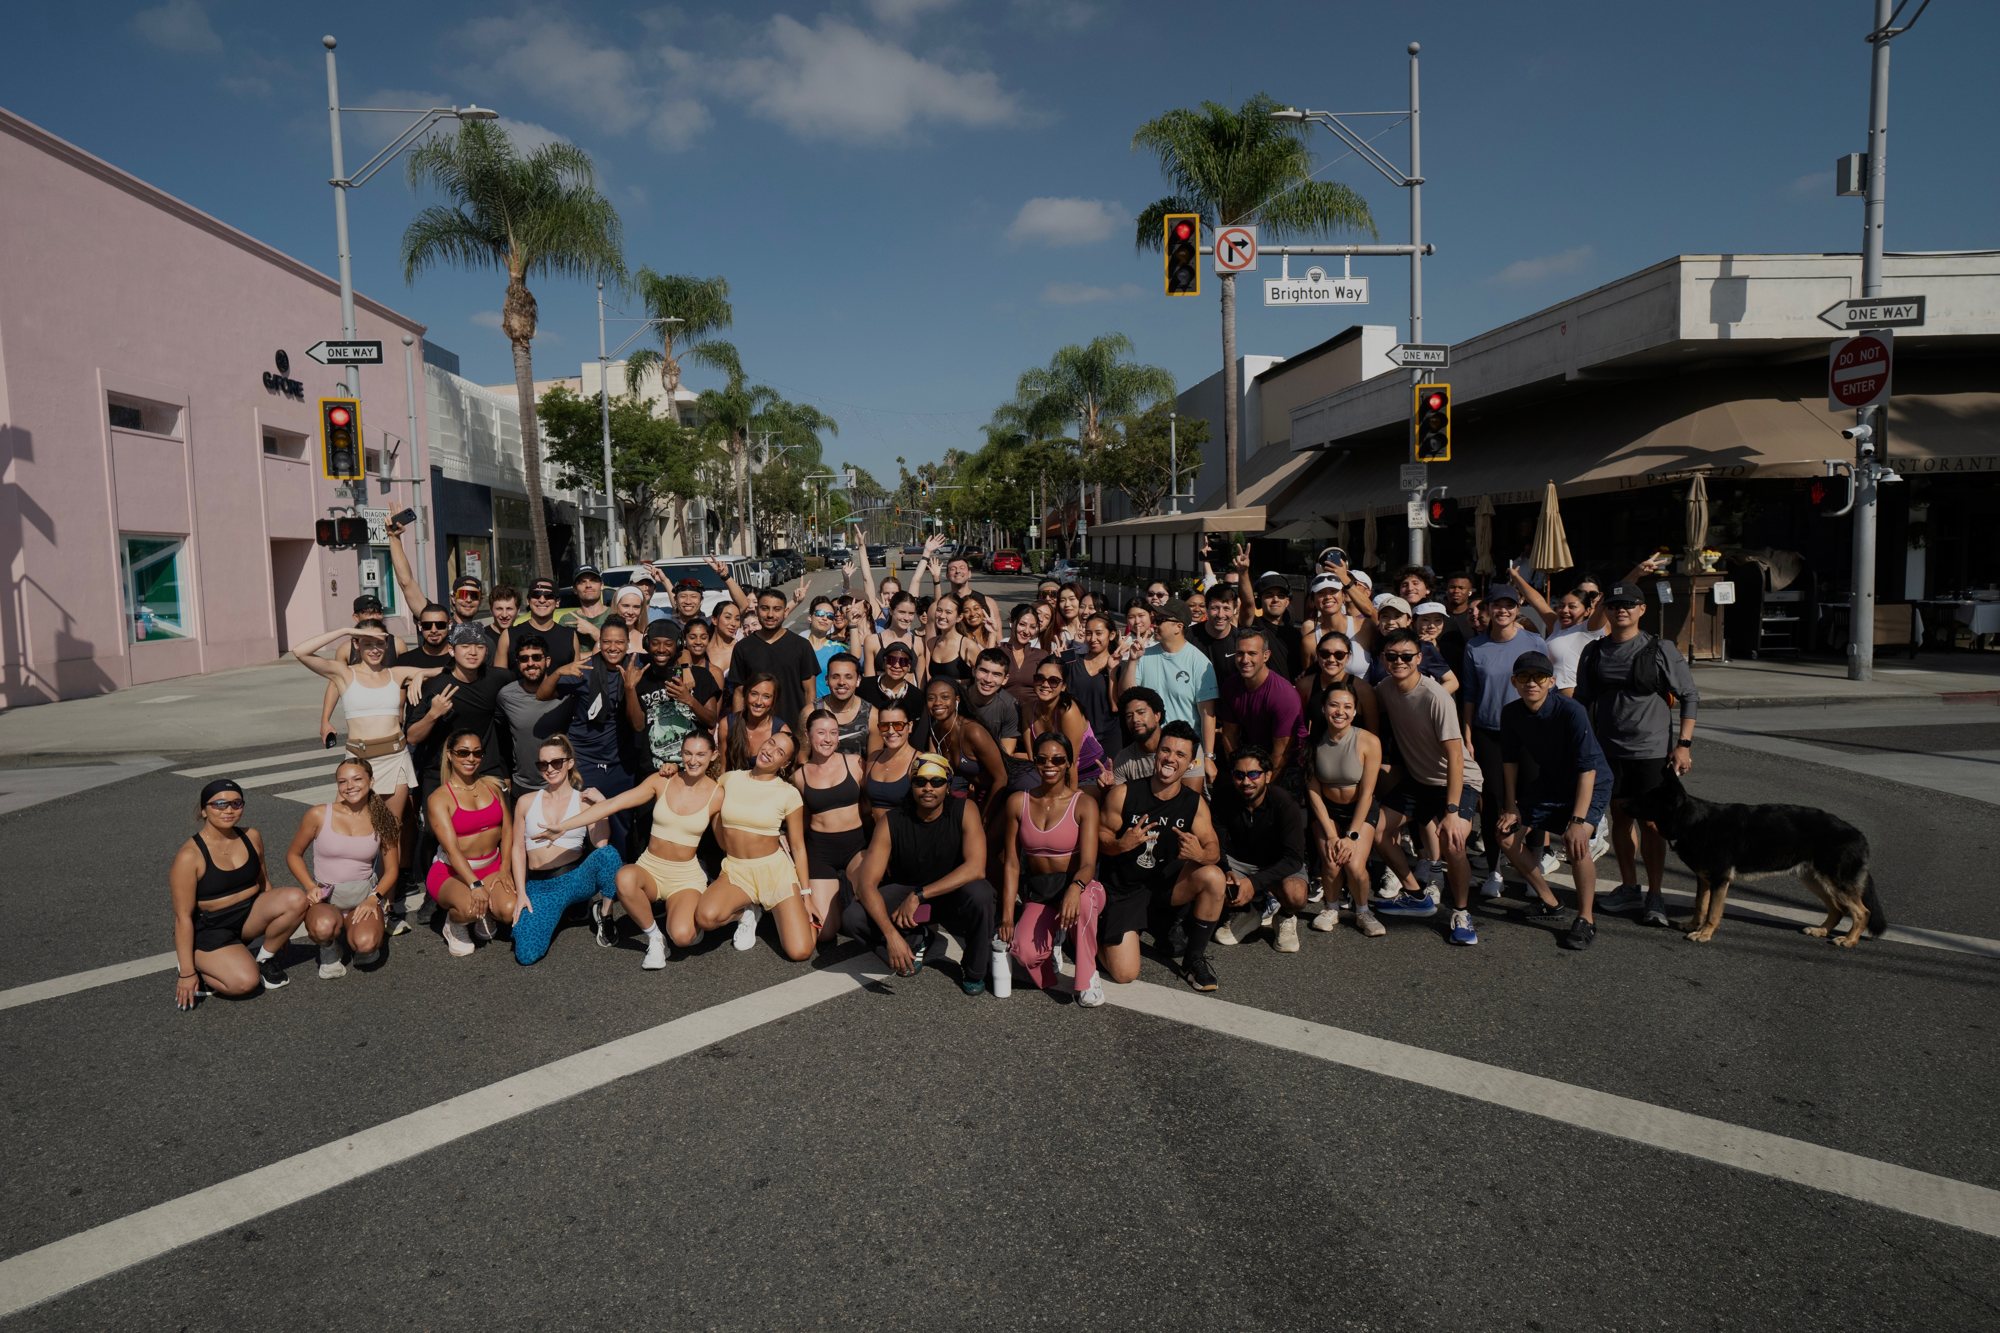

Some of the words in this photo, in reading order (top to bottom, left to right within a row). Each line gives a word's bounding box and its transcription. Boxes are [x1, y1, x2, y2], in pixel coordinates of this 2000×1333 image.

[1271, 287, 1330, 302] Brighton
[1335, 286, 1363, 301] Way
[1849, 308, 1877, 320] ONE
[1883, 306, 1913, 318] WAY
[328, 348, 349, 357] ONE
[353, 348, 374, 357] WAY
[1403, 351, 1421, 360] ONE
[1424, 352, 1442, 360] WAY
[1839, 352, 1854, 366] DO
[1860, 346, 1881, 361] NOT
[1842, 379, 1876, 396] ENTER
[1889, 456, 1998, 472] ISTORANT
[1618, 476, 1637, 489] IL
